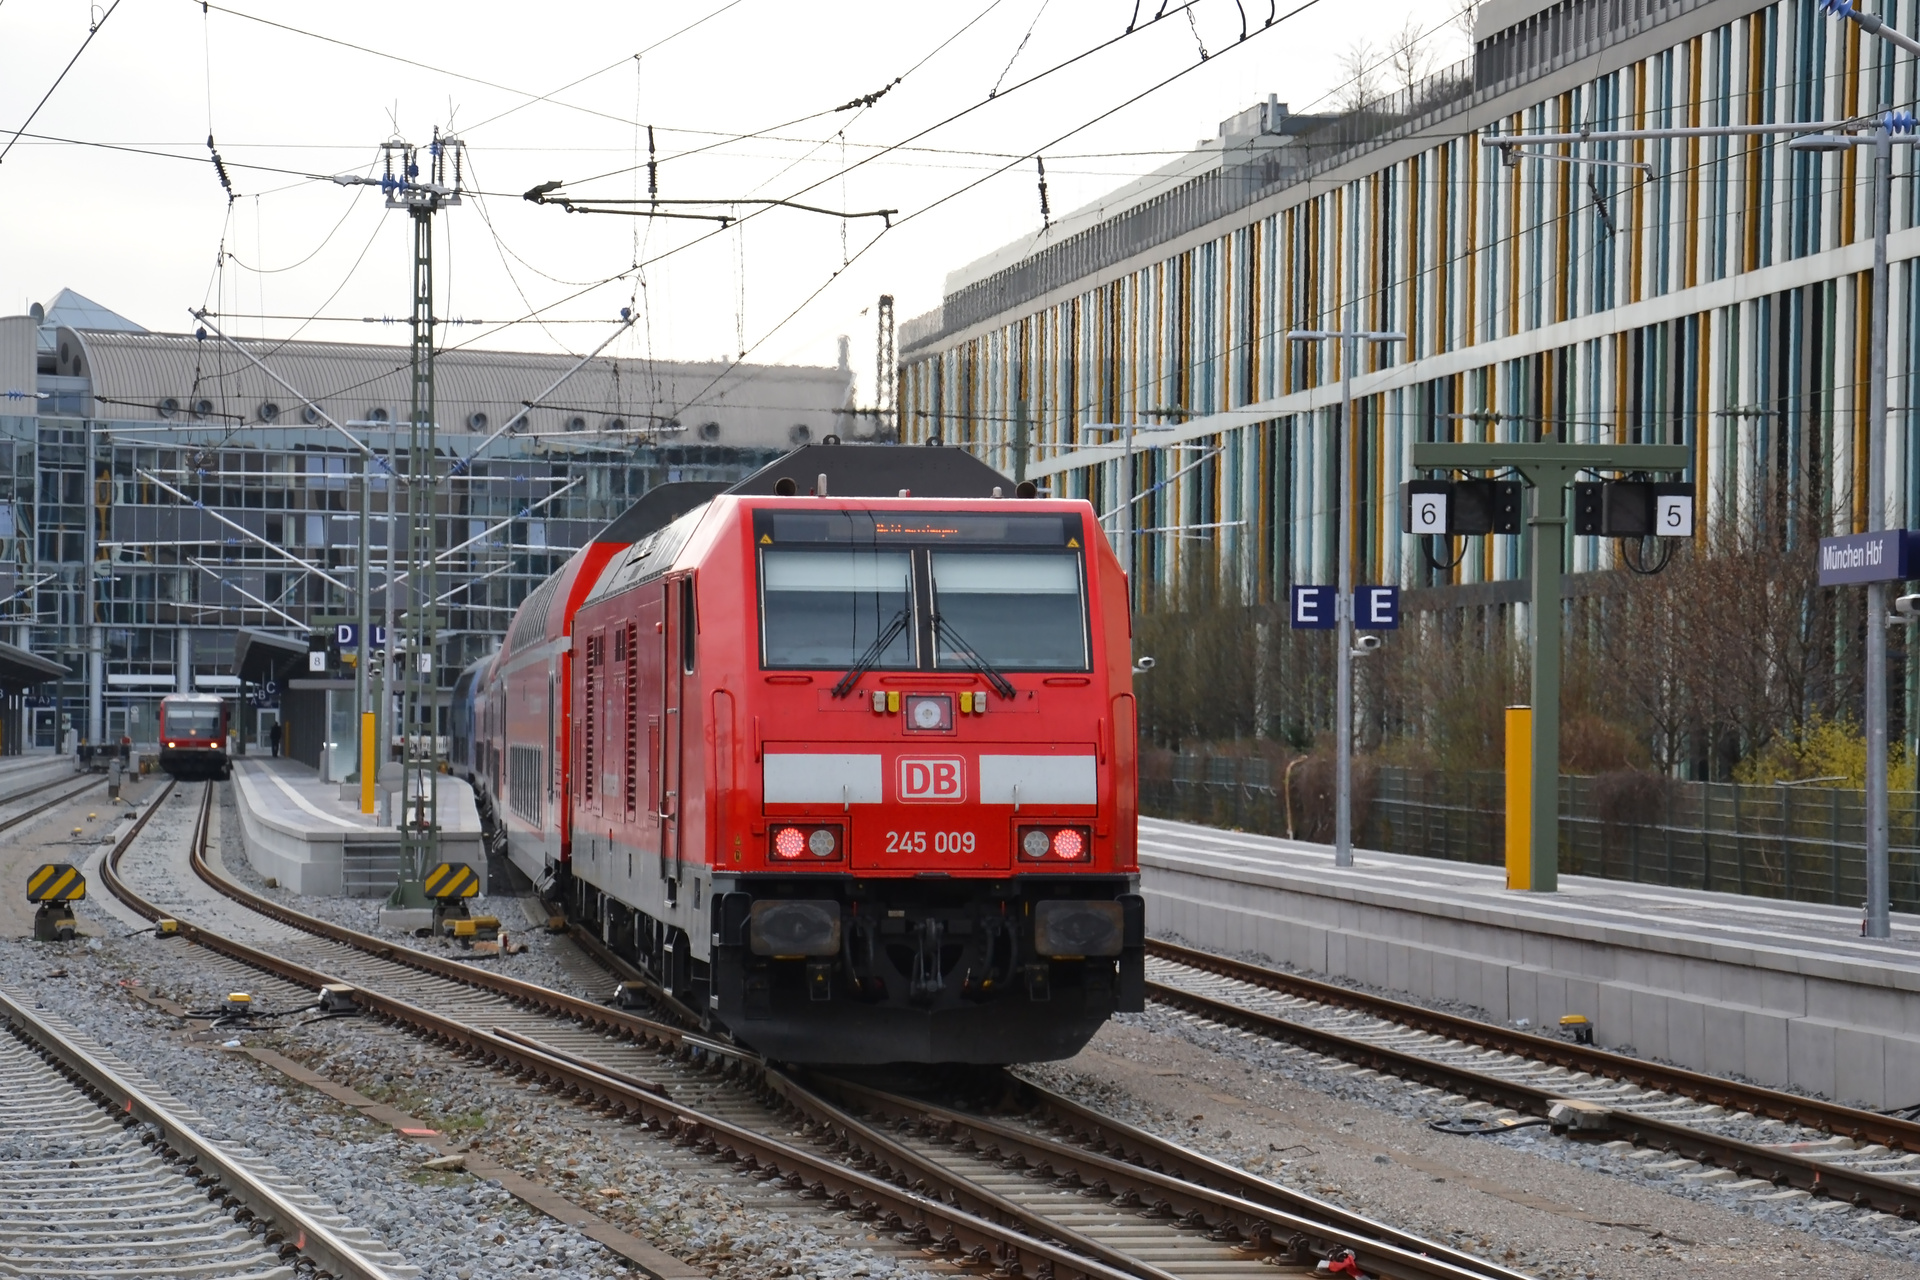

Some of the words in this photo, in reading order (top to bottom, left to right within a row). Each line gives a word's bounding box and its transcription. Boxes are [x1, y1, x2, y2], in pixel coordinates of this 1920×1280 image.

[1421, 502, 1437, 526] 6
[1667, 504, 1682, 528] 5
[1823, 543, 1864, 570] München
[1866, 539, 1884, 566] Hbf
[1297, 588, 1319, 622] E
[1371, 588, 1393, 622] E
[338, 625, 352, 643] D
[314, 657, 321, 666] 8
[421, 658, 428, 667] 7
[258, 690, 266, 700] B
[266, 681, 276, 694] C
[905, 763, 958, 795] DB
[885, 831, 927, 853] 245
[934, 831, 976, 854] 009
